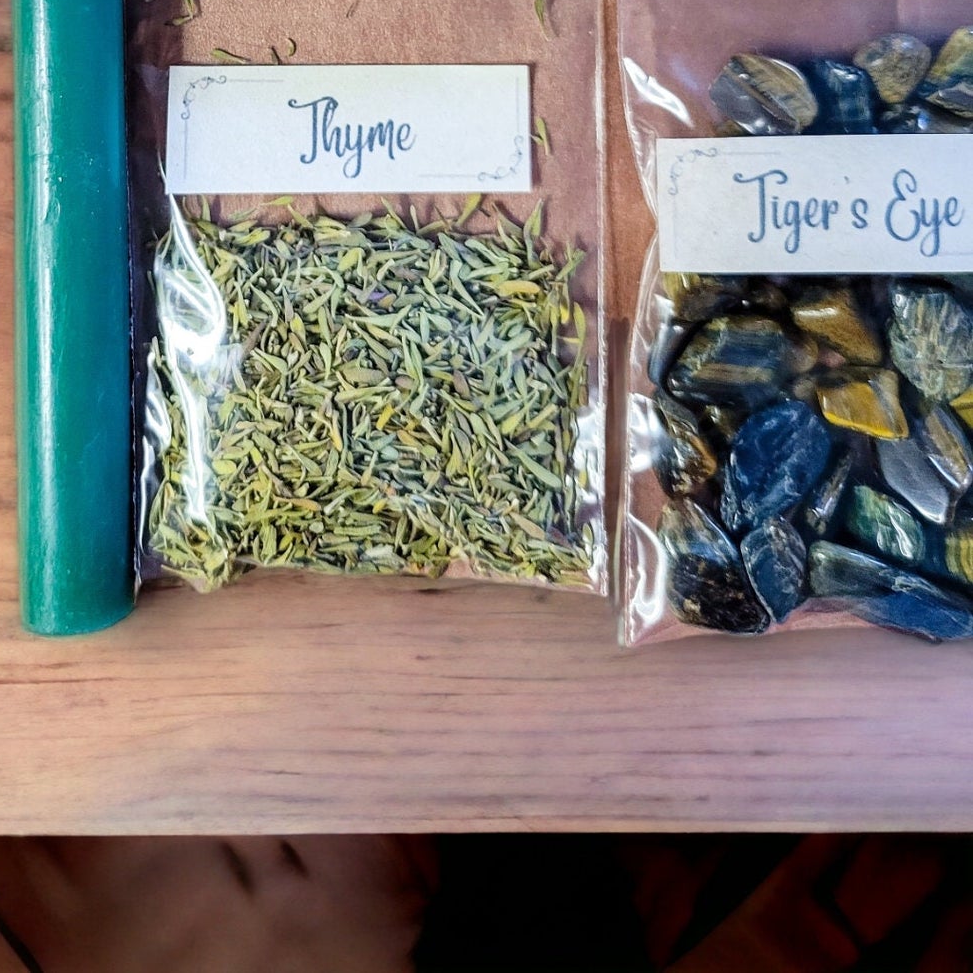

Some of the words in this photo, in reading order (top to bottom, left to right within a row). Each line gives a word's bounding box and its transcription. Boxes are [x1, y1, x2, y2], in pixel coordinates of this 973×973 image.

[288, 96, 416, 179] Thyme
[733, 169, 868, 254] Tiger's
[884, 168, 964, 257] Eye
